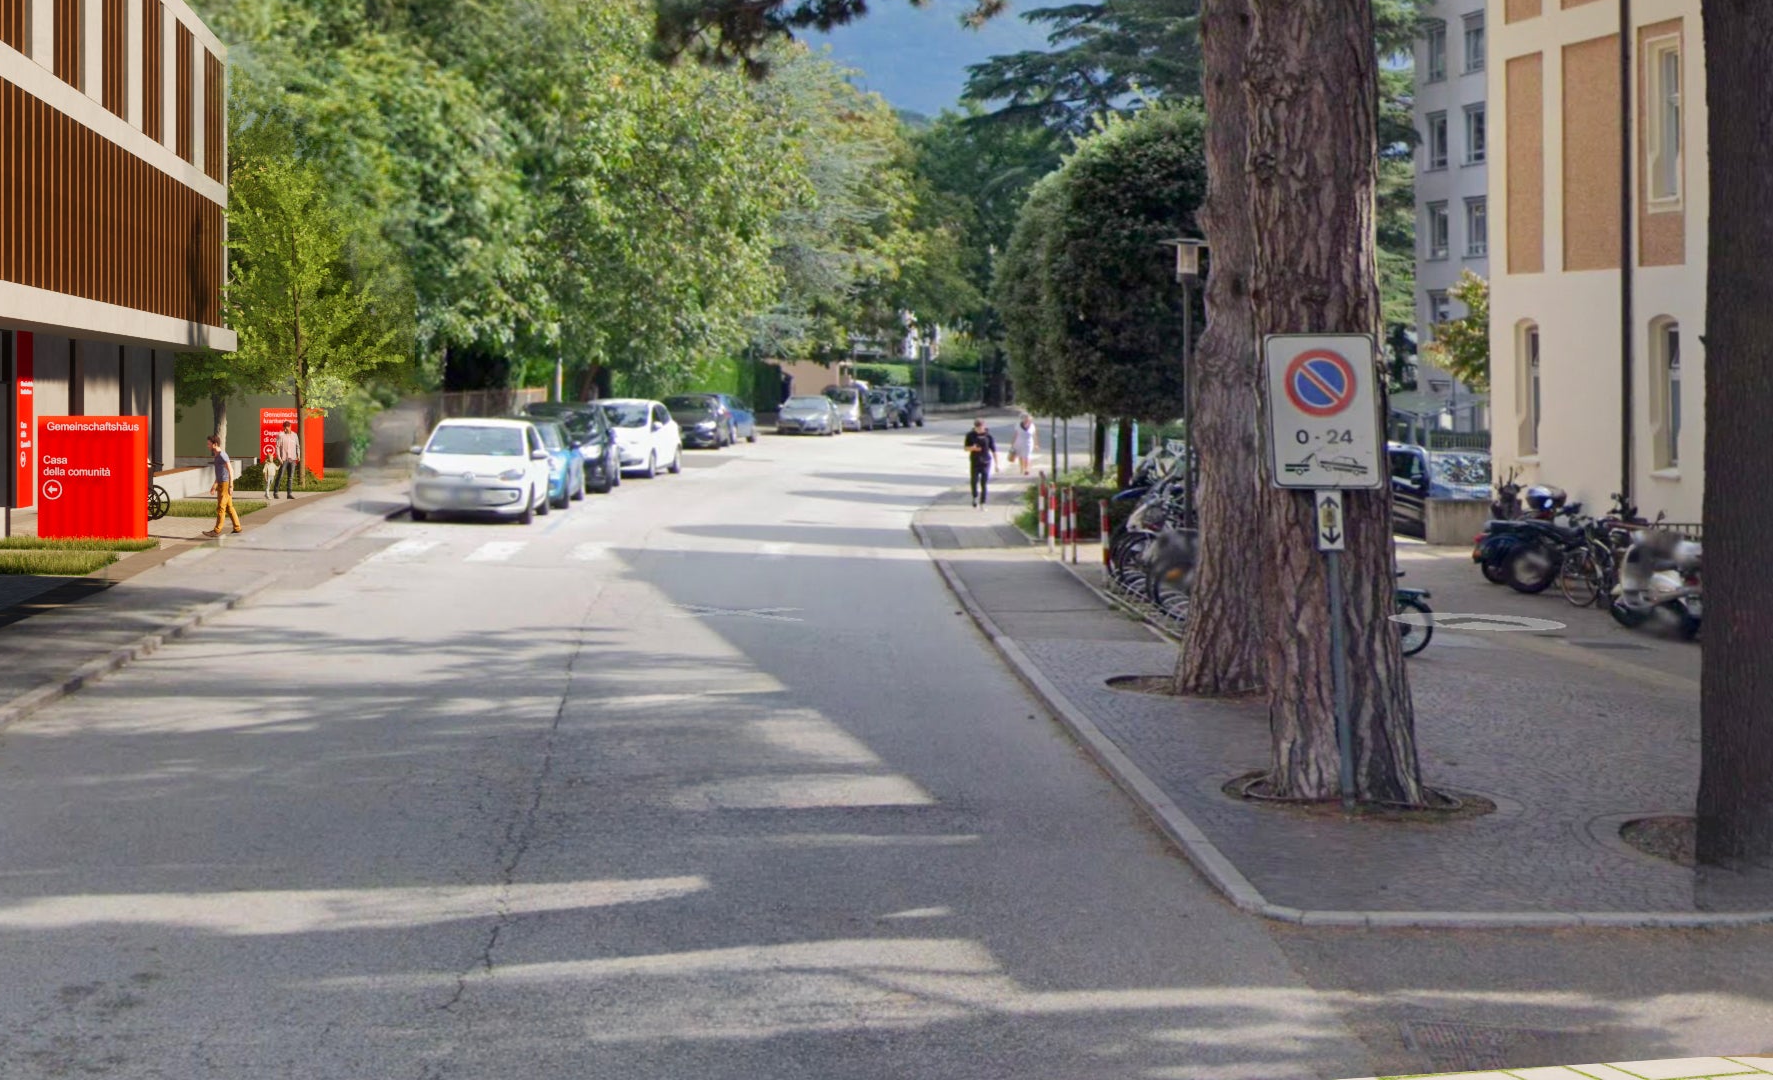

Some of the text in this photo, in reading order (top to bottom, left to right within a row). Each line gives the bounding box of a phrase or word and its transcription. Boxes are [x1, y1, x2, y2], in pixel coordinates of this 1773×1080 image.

[1326, 429, 1354, 445] 24
[43, 455, 68, 465] Casa
[43, 467, 111, 477] della comunità
